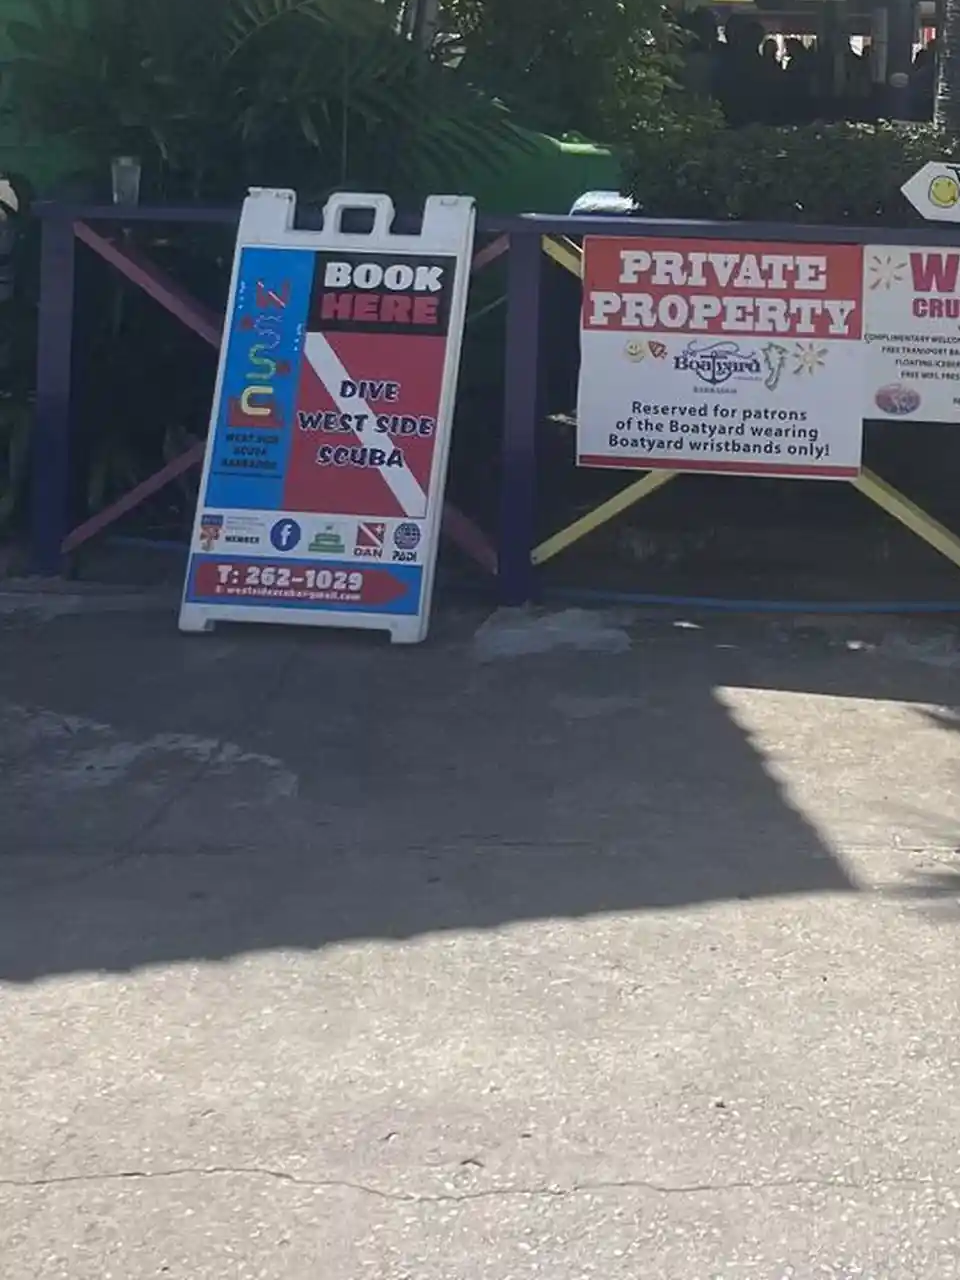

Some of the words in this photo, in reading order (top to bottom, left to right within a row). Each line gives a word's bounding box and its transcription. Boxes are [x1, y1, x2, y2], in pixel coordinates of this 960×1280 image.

[324, 261, 443, 292] BOOK
[619, 250, 827, 290] PRIVATE
[321, 291, 439, 324] HERE
[589, 291, 856, 335] PROPERTY
[672, 352, 762, 376] Boatyard
[340, 380, 400, 403] DIVE
[632, 401, 709, 418] Reserved
[713, 404, 738, 418] for
[742, 408, 807, 422] patrons
[299, 411, 369, 433] WEST
[374, 413, 435, 438] SIDE
[616, 417, 633, 431] of
[637, 418, 664, 433] the
[669, 420, 745, 437] Boatyard
[750, 424, 819, 442] wearing
[317, 444, 405, 469] SCUBA
[609, 434, 684, 453] Boatyard
[689, 438, 781, 455] wristbands
[787, 442, 829, 460] only!
[225, 535, 260, 544] MEMBER
[353, 547, 383, 558] DAN
[217, 564, 240, 585] T:
[246, 565, 364, 592] 262-1029
